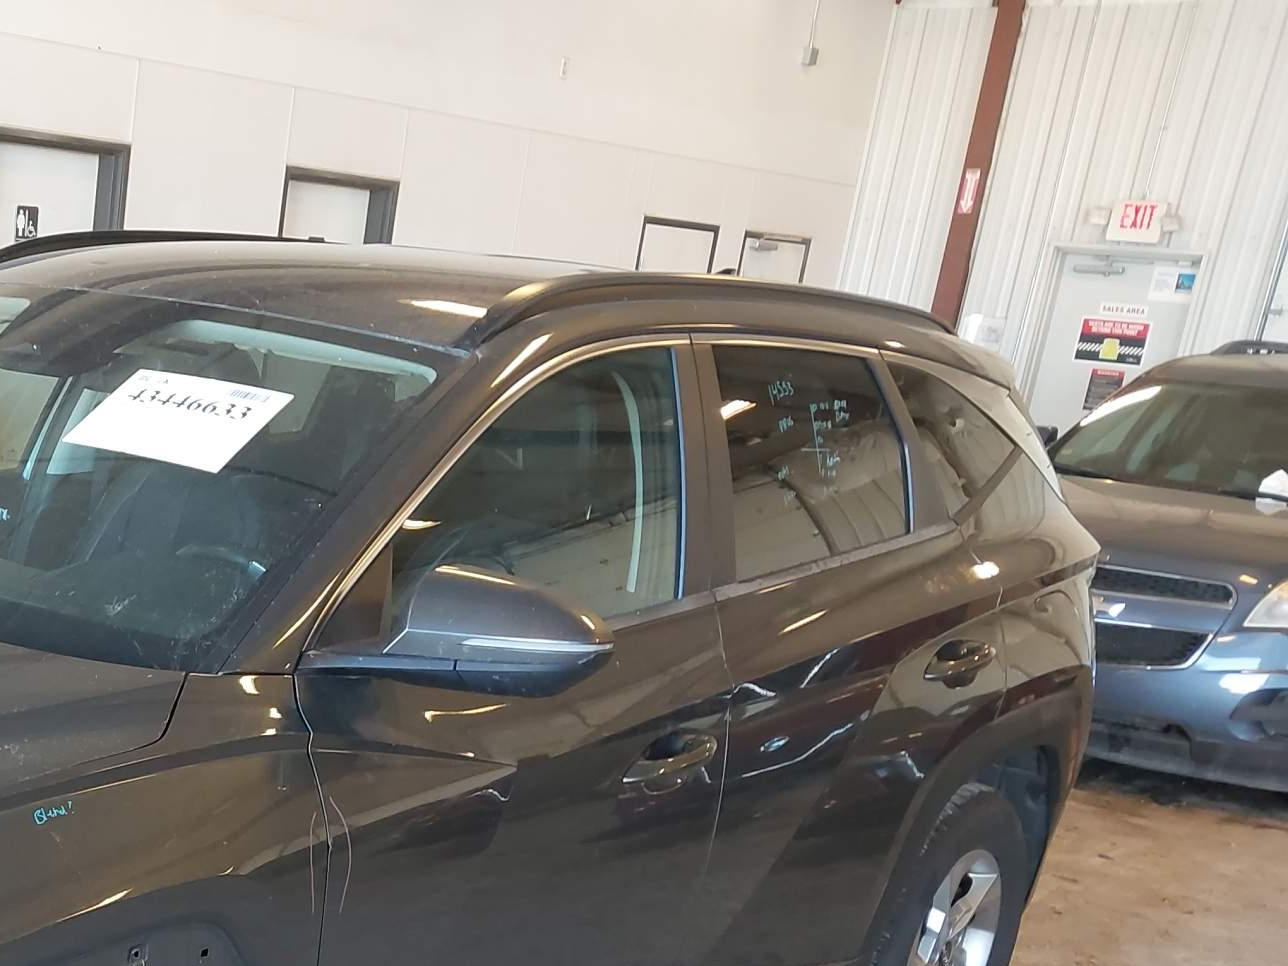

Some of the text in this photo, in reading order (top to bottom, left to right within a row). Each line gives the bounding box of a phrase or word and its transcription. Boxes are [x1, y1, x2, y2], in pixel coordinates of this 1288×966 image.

[1120, 203, 1159, 230] EXIT
[1102, 305, 1145, 315] SALES AREA
[128, 388, 253, 421] 43446633
